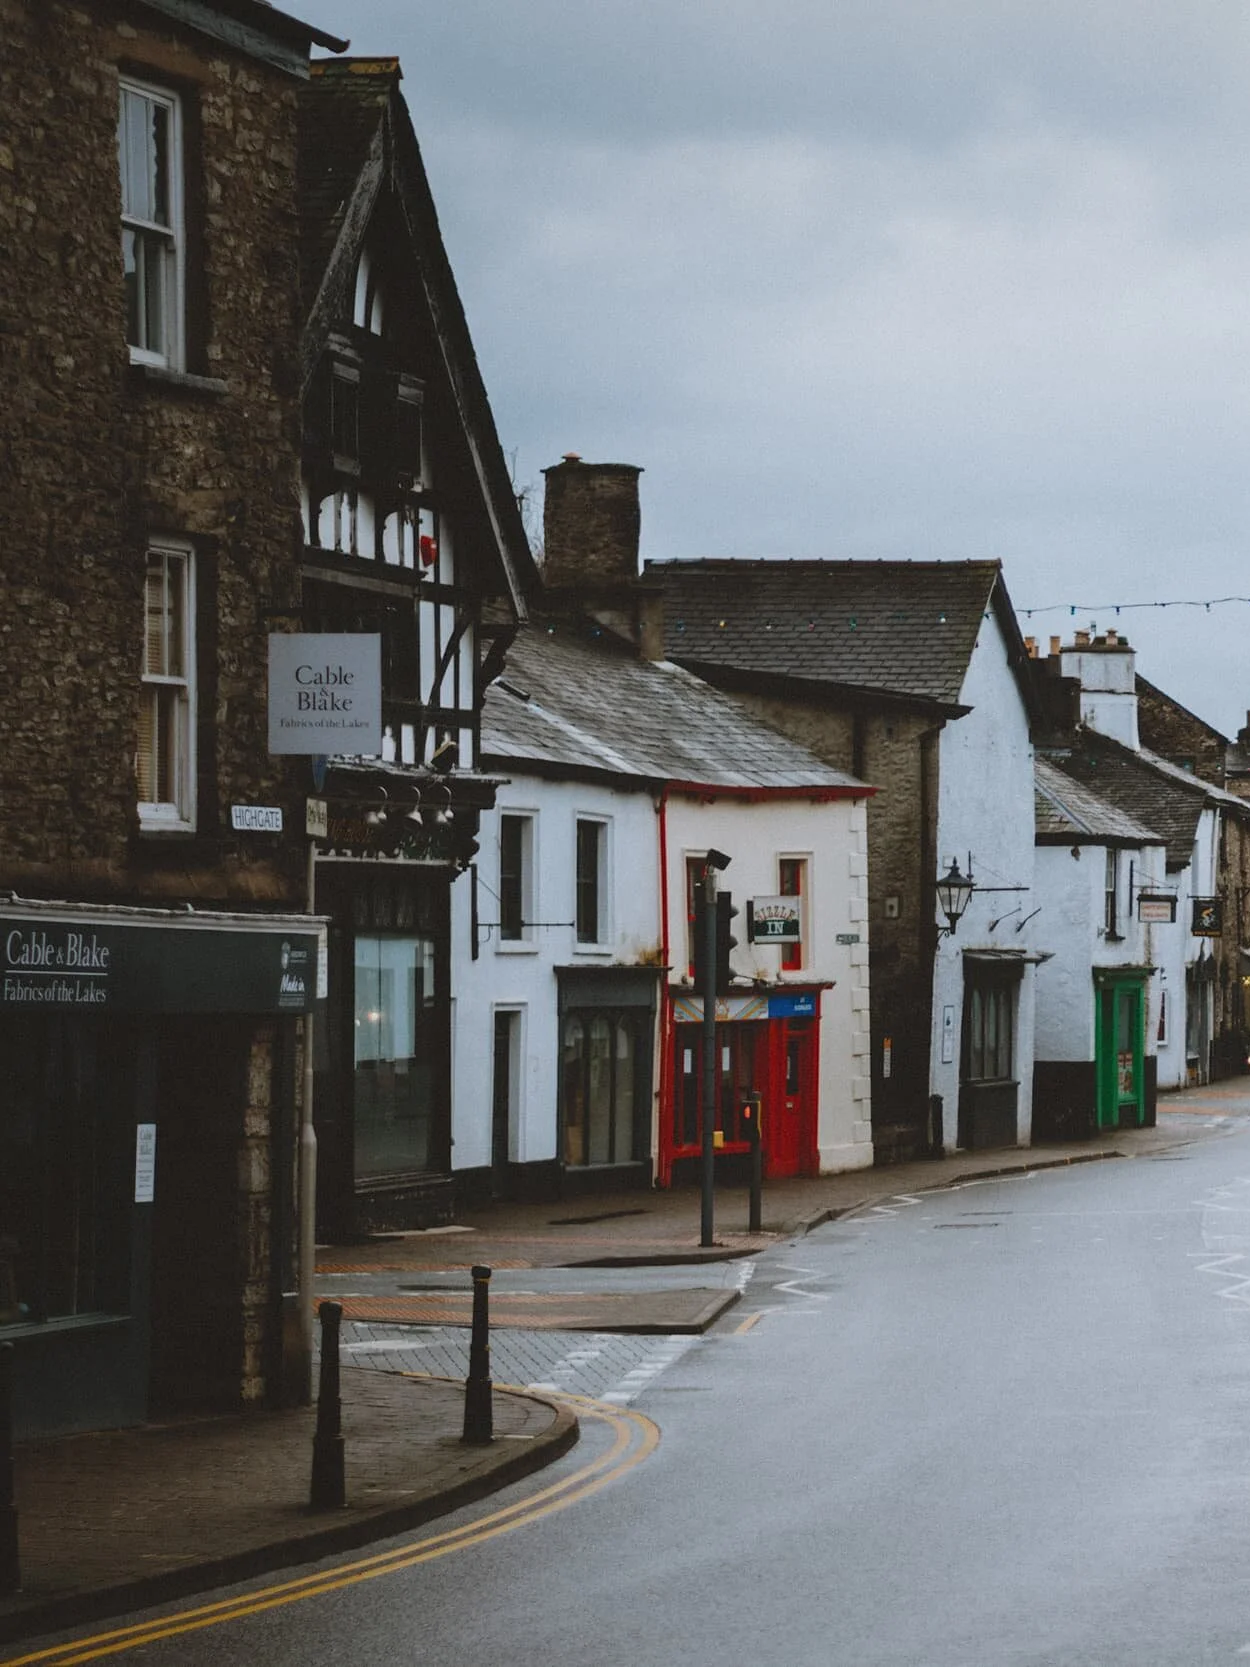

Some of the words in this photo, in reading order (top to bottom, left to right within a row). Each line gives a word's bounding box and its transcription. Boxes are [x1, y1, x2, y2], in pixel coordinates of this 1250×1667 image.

[295, 664, 354, 685] Cable
[297, 691, 353, 711] Blake
[320, 687, 329, 697] &
[280, 718, 313, 728] Fabrics
[315, 719, 324, 728] of
[325, 718, 340, 728] the
[342, 718, 370, 728] Lakes
[234, 807, 280, 828] HIGHGATE
[754, 904, 796, 921] SIZZLE
[766, 921, 785, 934] IN
[6, 930, 55, 966] Cable
[56, 948, 64, 965] &
[66, 933, 110, 968] Blake
[4, 978, 43, 1001] Fabrics
[44, 979, 58, 1001] of
[58, 979, 74, 1002] the
[75, 979, 107, 1003] Lakes
